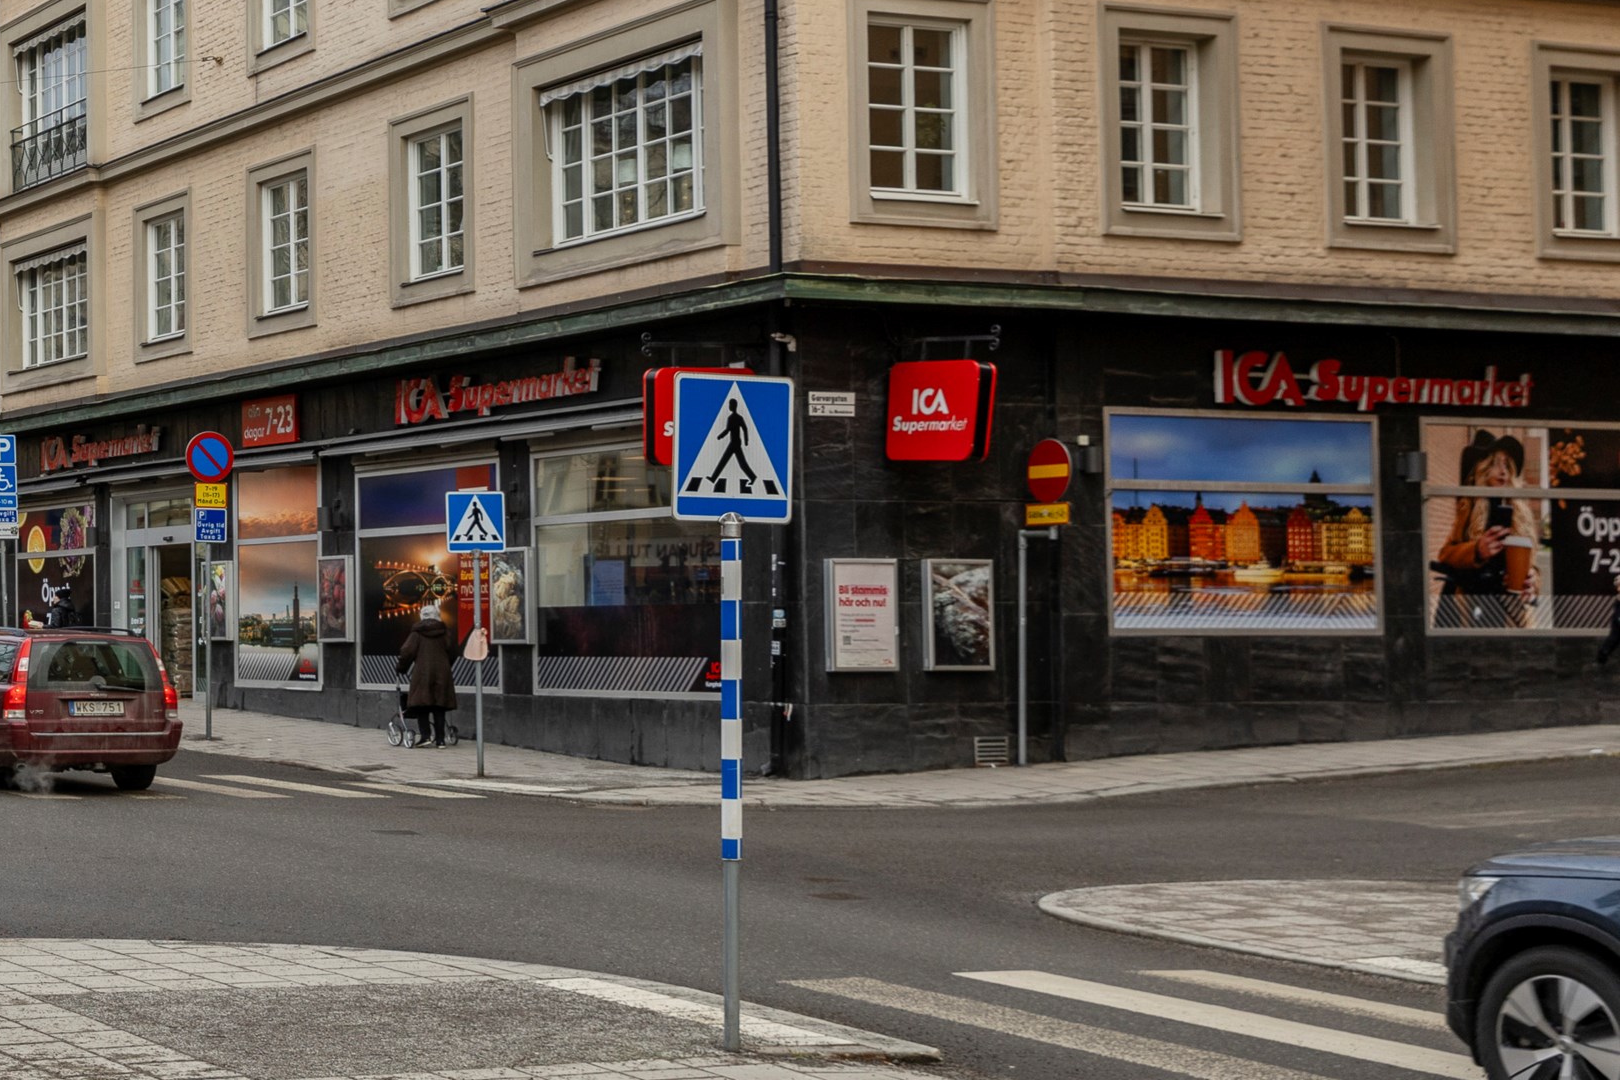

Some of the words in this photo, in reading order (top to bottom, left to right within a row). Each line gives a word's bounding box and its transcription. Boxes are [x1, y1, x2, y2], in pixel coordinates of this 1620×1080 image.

[395, 374, 449, 424] ICA
[449, 356, 601, 416] Supermarket
[1214, 349, 1306, 407] ICA
[1308, 358, 1534, 411] Supermarket
[911, 388, 949, 415] ICA
[264, 404, 294, 435] 7-23
[892, 415, 968, 434] Supermarket
[243, 426, 265, 441] dagar
[40, 435, 72, 472] ICA
[71, 424, 160, 468] Supermarket
[1577, 505, 1620, 542] Öpp
[838, 585, 849, 595] Bli
[851, 585, 888, 595] stammis
[838, 597, 853, 607] här
[855, 598, 870, 607] och
[873, 598, 886, 607] nu!
[75, 701, 96, 713] WKS
[101, 701, 122, 713] 751
